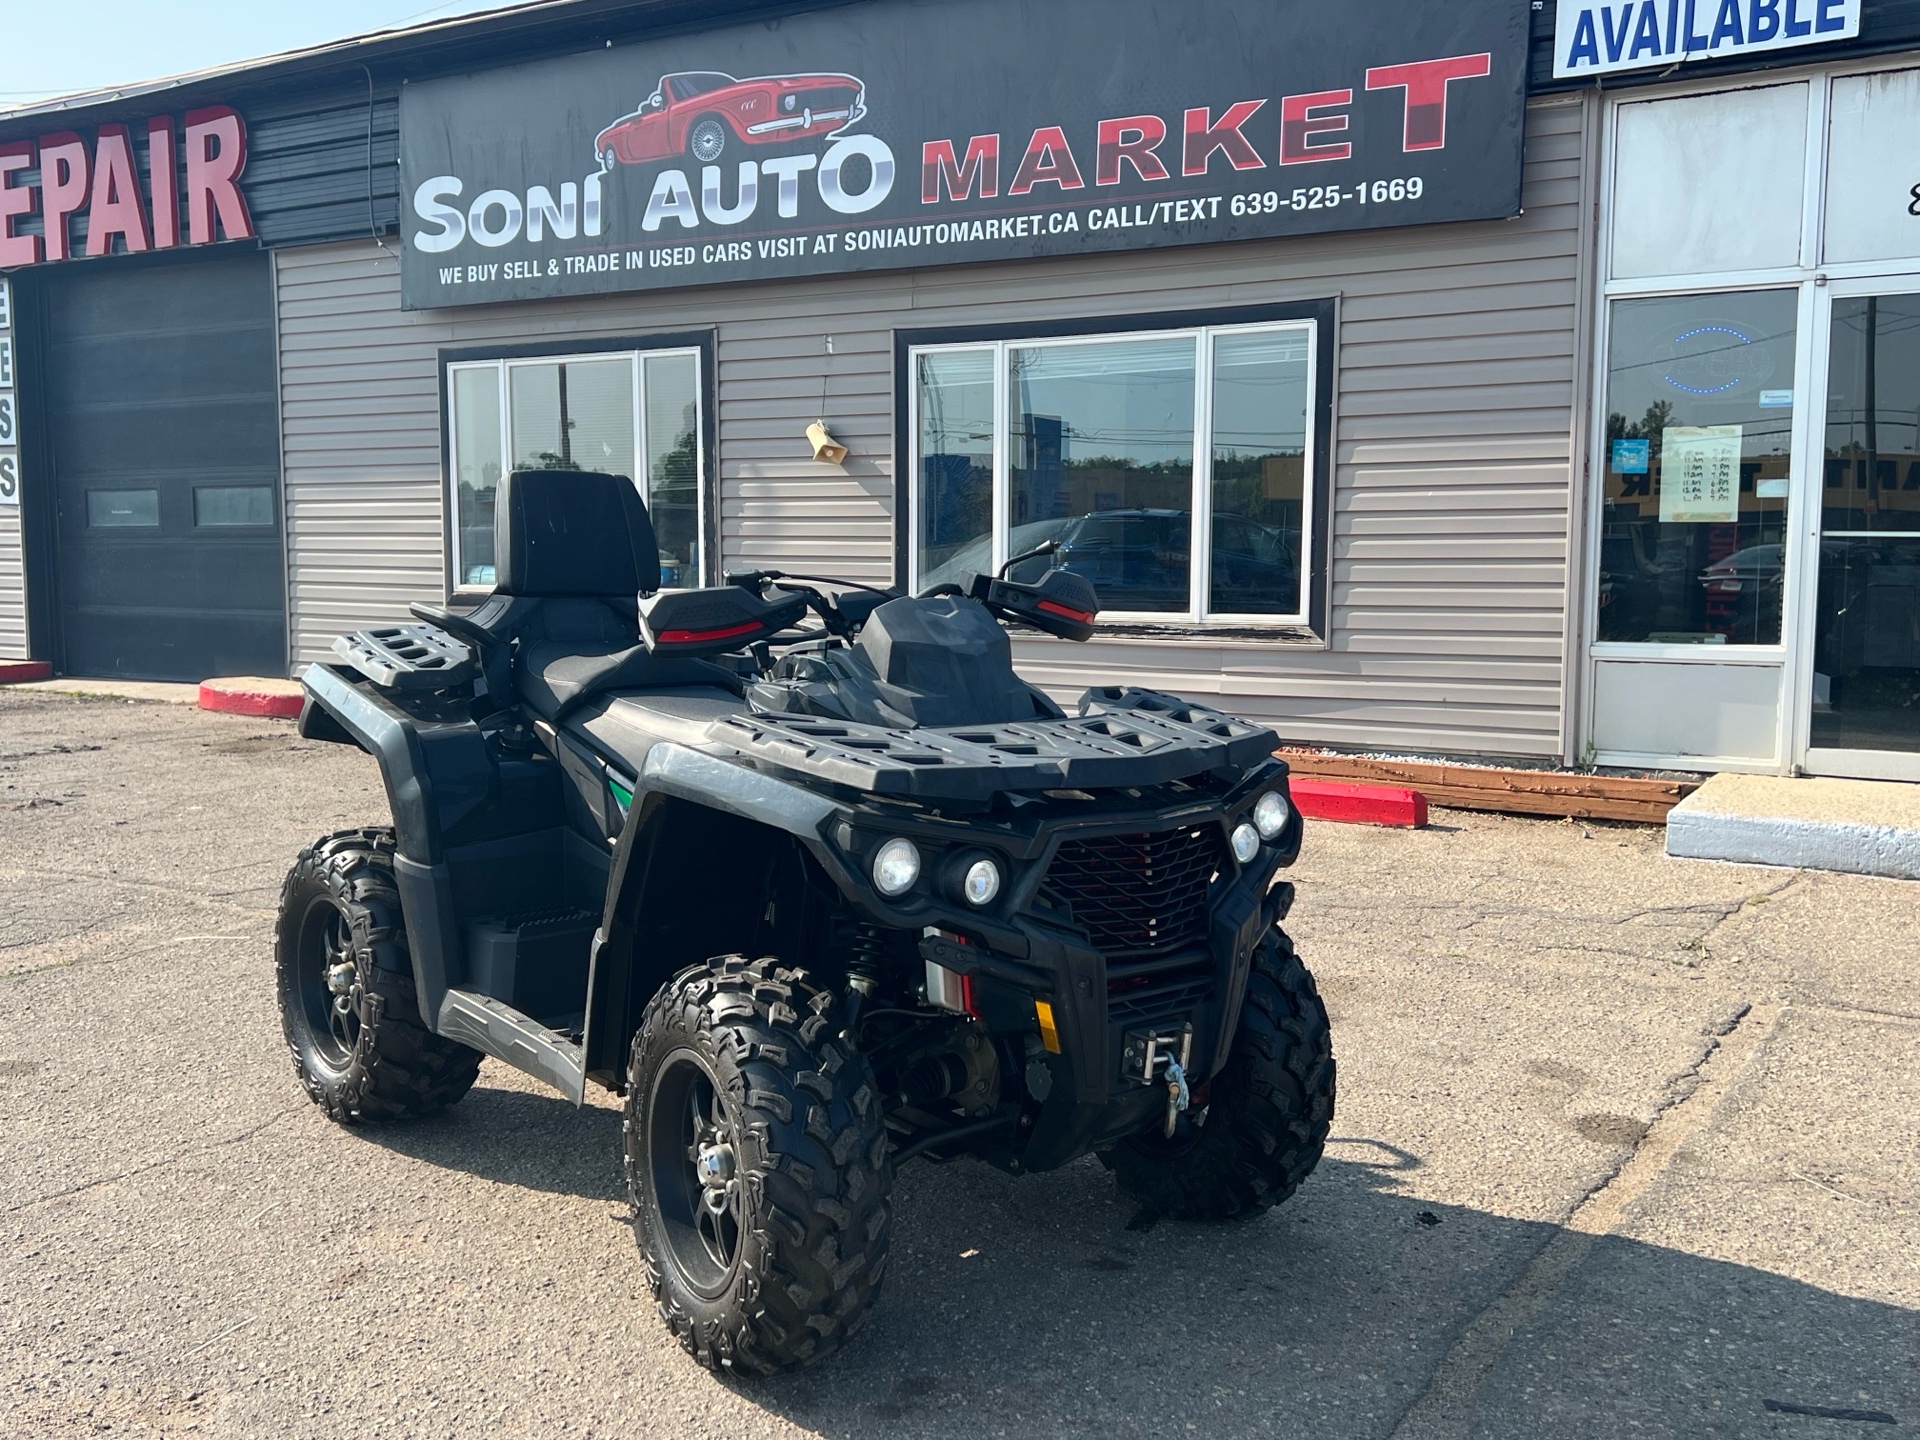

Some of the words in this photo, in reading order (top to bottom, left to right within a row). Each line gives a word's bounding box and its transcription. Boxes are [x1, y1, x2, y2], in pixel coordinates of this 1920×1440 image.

[1567, 0, 1845, 68] AVAILABLE
[413, 174, 602, 254] SONI
[641, 133, 896, 232] AUTO
[921, 52, 1492, 204] MARKET
[438, 267, 463, 285] WE
[467, 262, 498, 282] BUY
[503, 259, 543, 279] SELL
[547, 259, 559, 276] &
[564, 252, 620, 275] TRADE
[625, 251, 644, 270] IN
[648, 246, 697, 269] USED
[702, 242, 753, 264] CARS
[757, 236, 808, 260] VISIT
[813, 234, 838, 254] AT
[844, 211, 1080, 252] SONIAUTOMARKET.CA
[1087, 194, 1223, 231] CALL/TEXT
[1229, 175, 1424, 217] 639-525-1669
